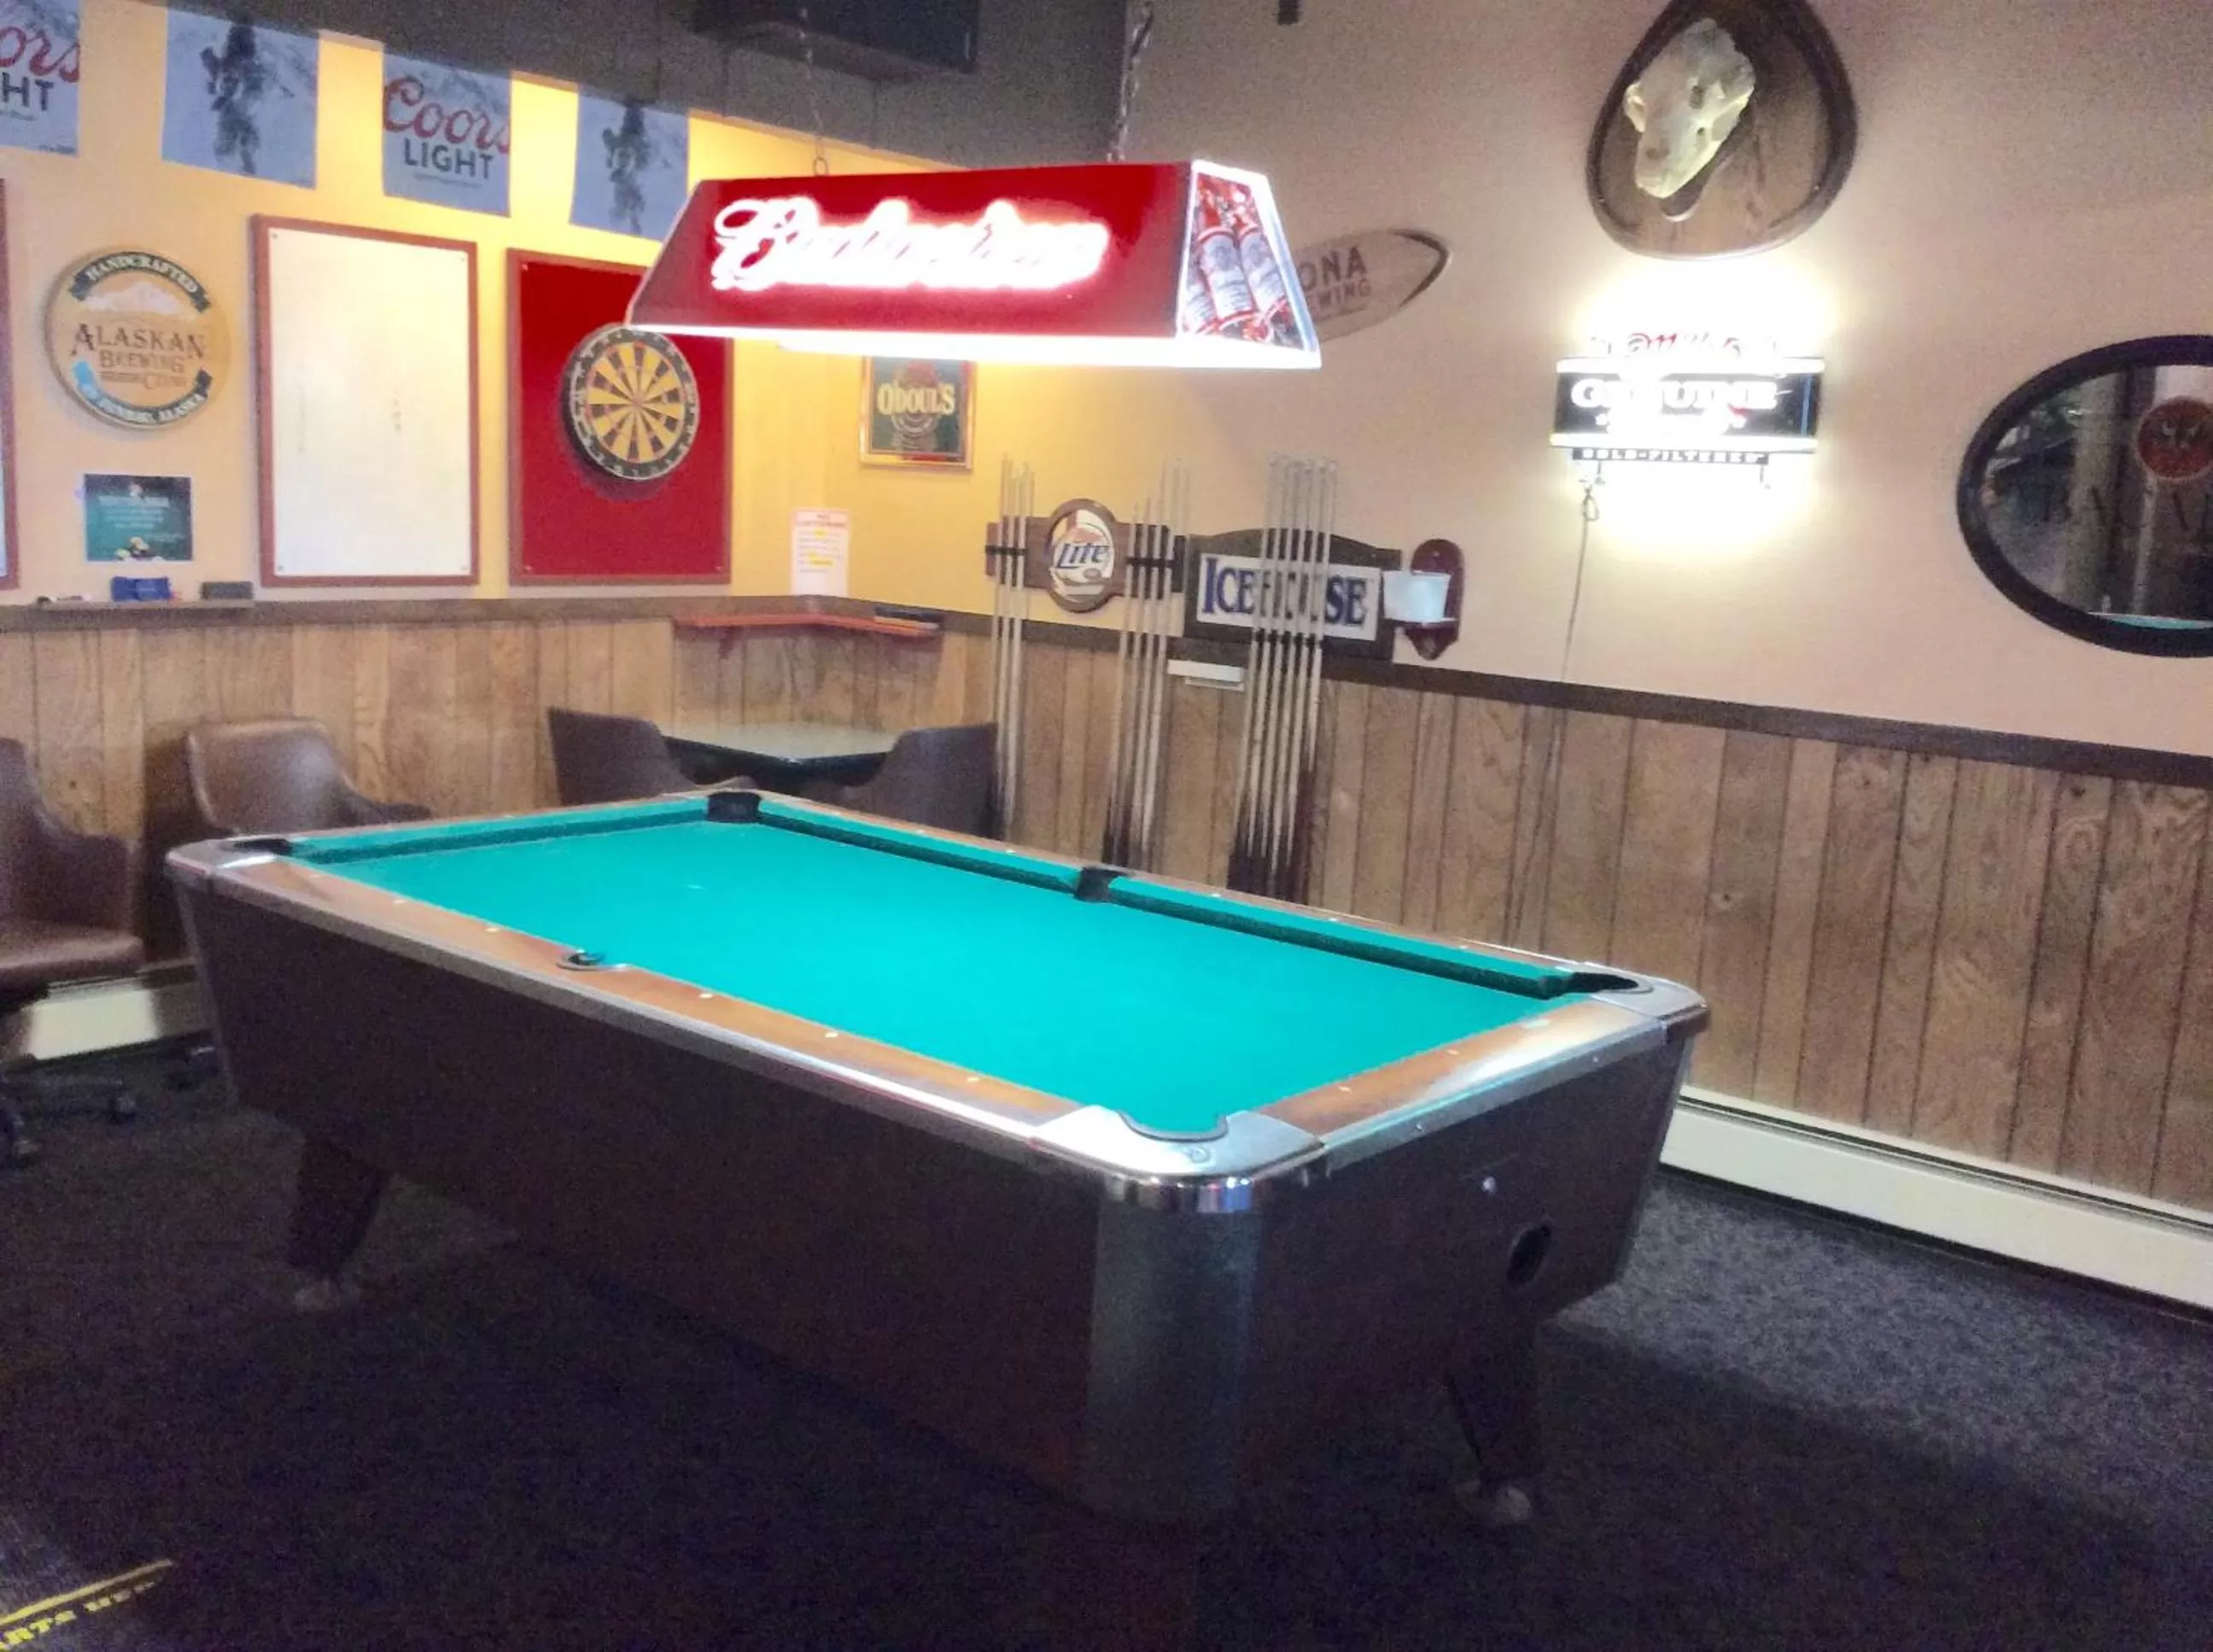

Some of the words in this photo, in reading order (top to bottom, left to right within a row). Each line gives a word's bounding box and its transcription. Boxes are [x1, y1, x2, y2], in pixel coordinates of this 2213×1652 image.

[0, 26, 80, 83] ors
[403, 137, 495, 180] LIGHT
[1295, 245, 1369, 293] ONA
[71, 323, 205, 359] ALASKAN
